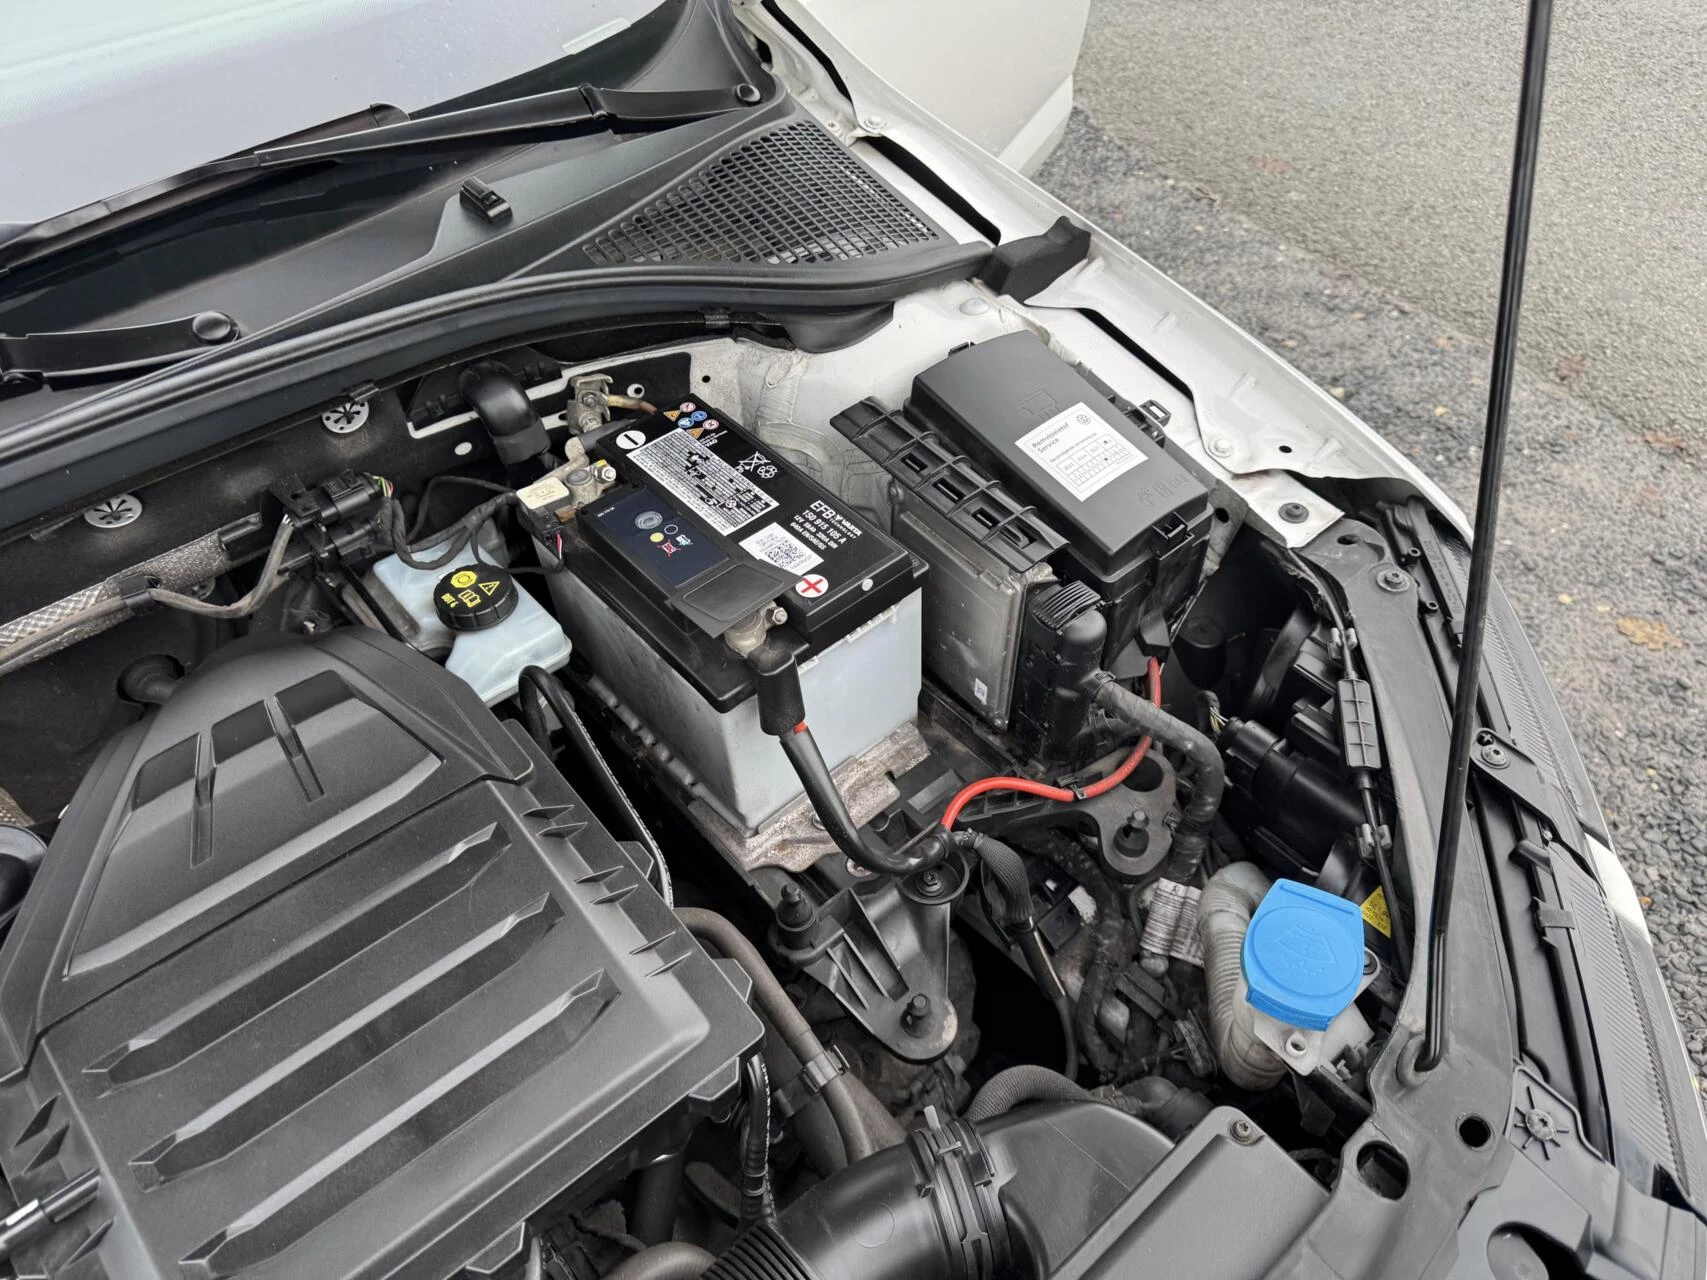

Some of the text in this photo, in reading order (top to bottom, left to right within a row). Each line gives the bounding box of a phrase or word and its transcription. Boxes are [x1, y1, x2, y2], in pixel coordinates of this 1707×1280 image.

[1037, 438, 1059, 453] Service
[810, 500, 836, 519] EFB
[814, 518, 829, 531] 915
[827, 528, 842, 540] 105
[838, 537, 847, 545] A
